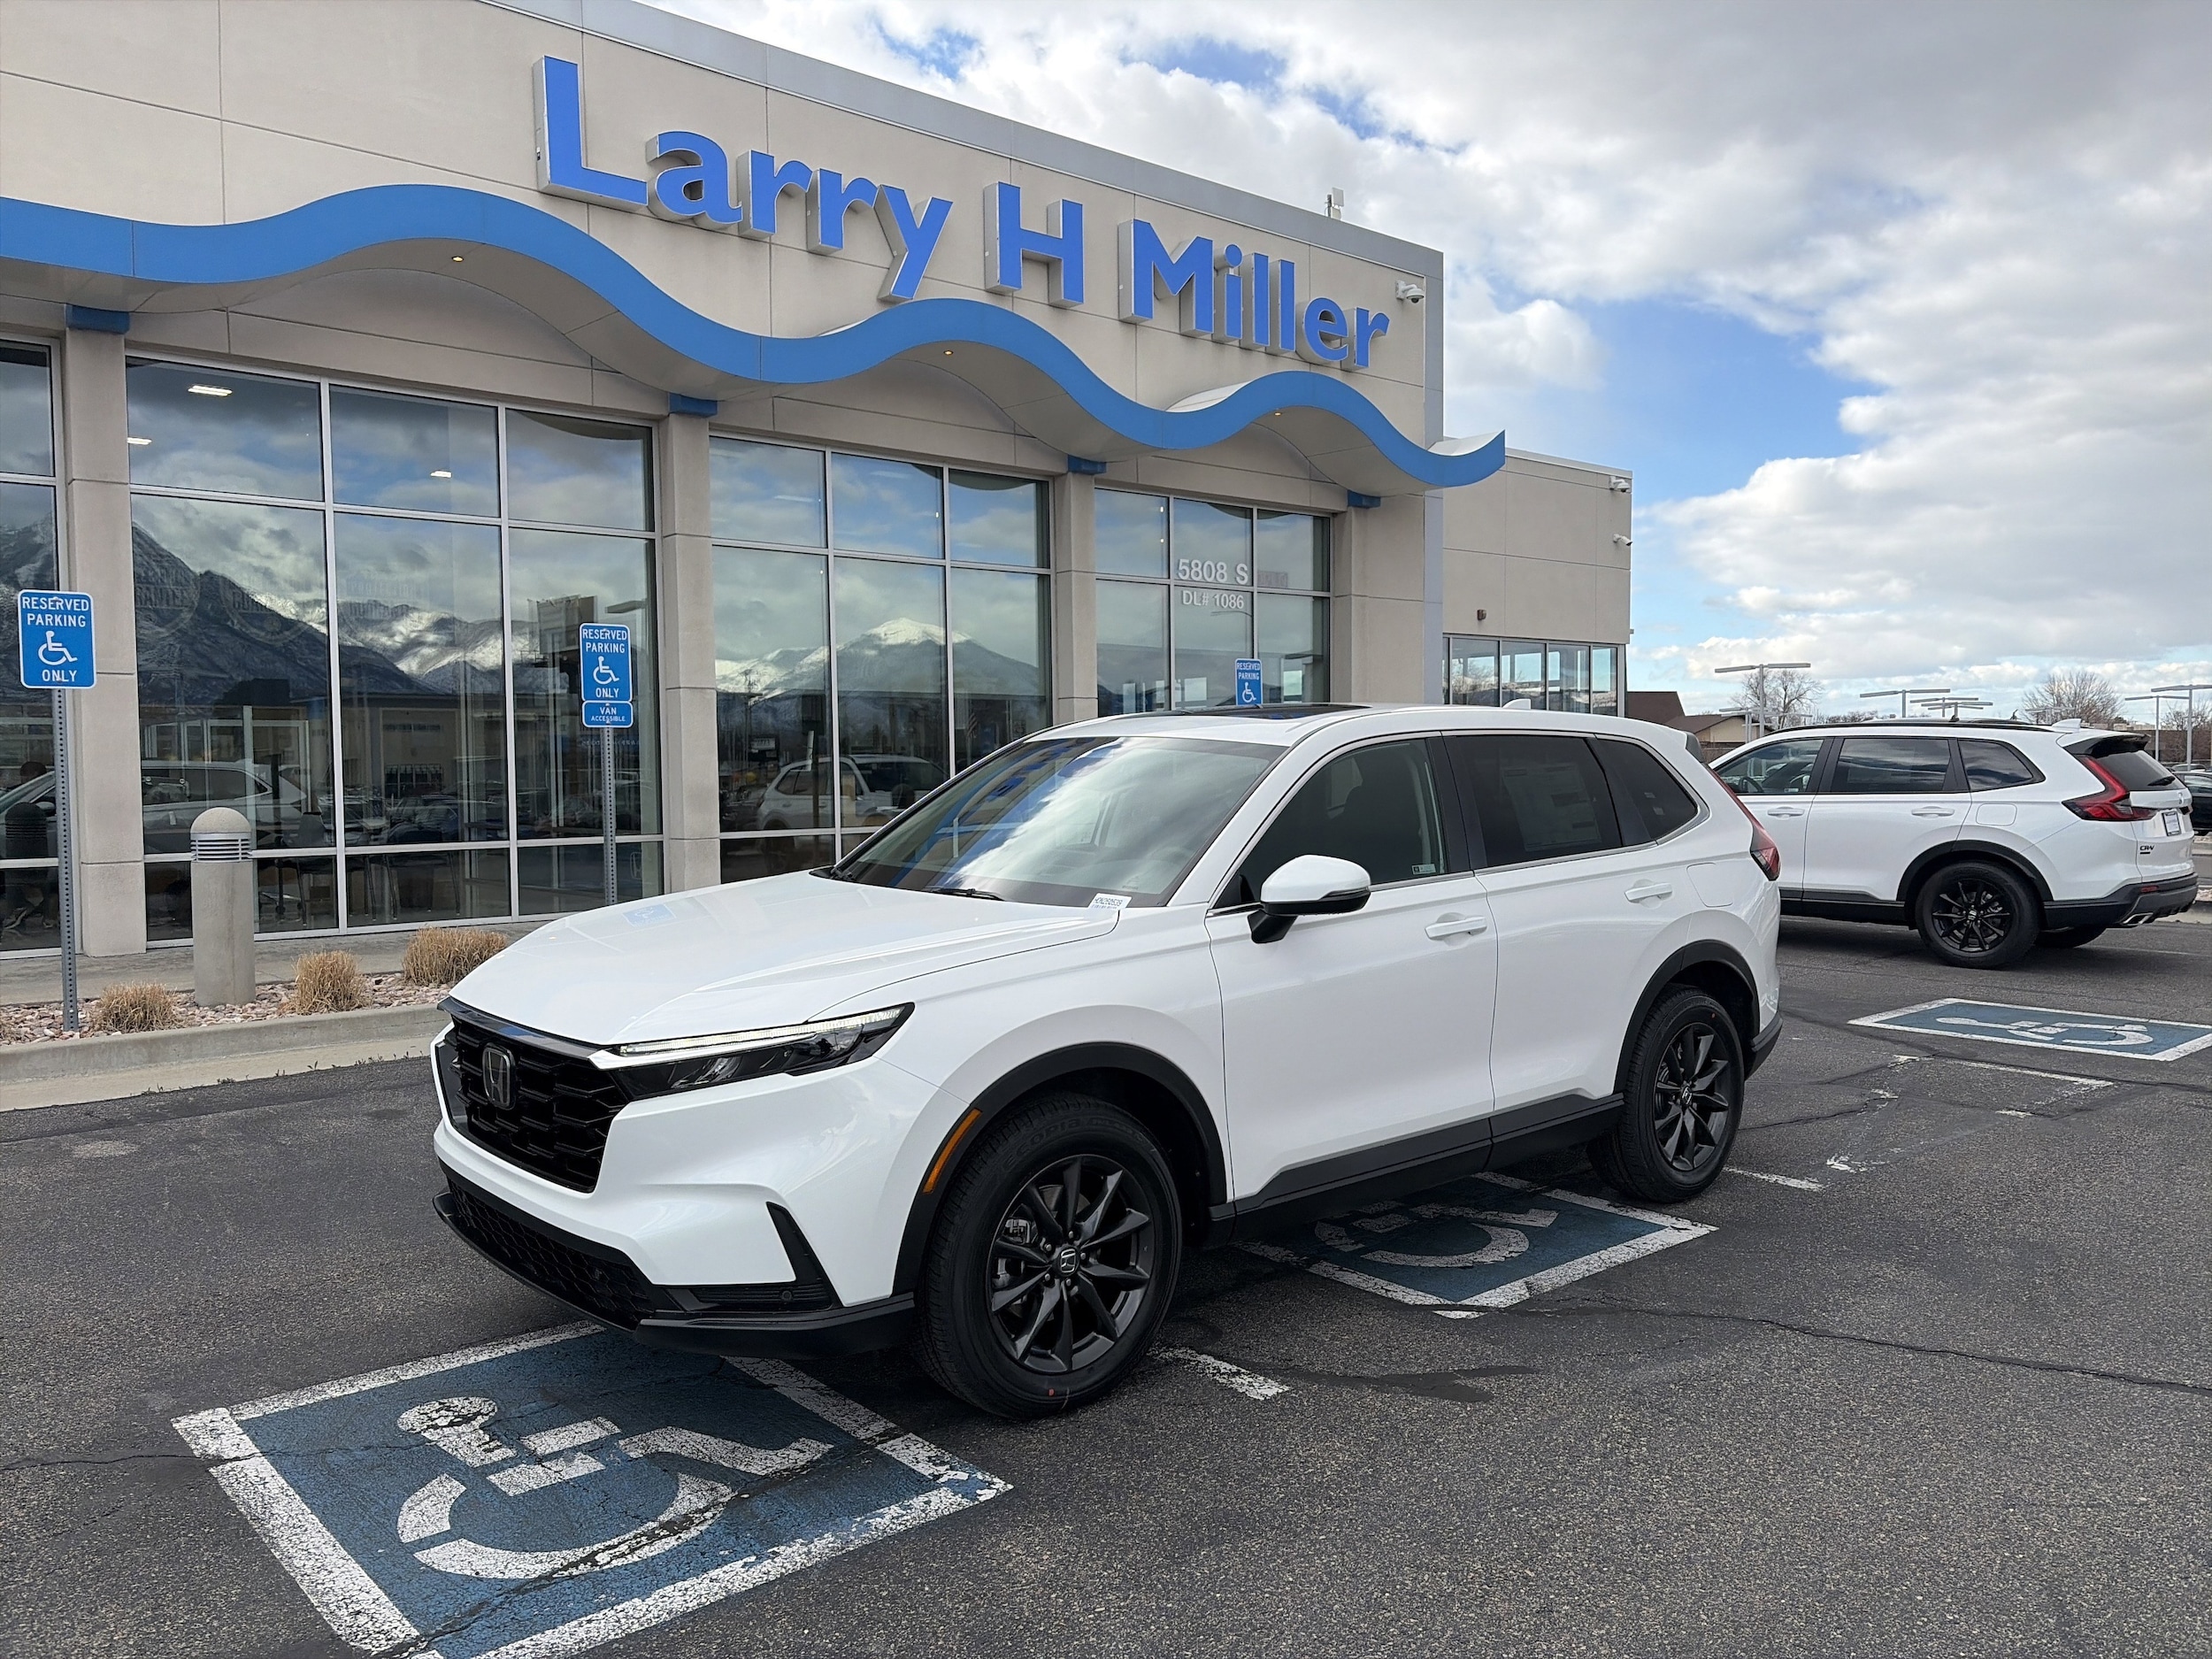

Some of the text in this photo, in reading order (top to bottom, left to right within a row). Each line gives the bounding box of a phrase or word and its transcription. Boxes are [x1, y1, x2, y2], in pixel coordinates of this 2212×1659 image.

[538, 56, 1391, 368] Larry H Miller
[1178, 558, 1248, 585] 5808 S
[21, 596, 89, 611] RESERVED
[1182, 590, 1245, 609] DL# 1086
[27, 612, 87, 627] PARKING
[582, 628, 627, 641] RESERVED
[586, 641, 626, 654] PARKING
[1236, 662, 1261, 671] RESERVED
[42, 669, 78, 682] ONLY
[1238, 672, 1260, 680] PARKING
[595, 687, 619, 698] ONLY
